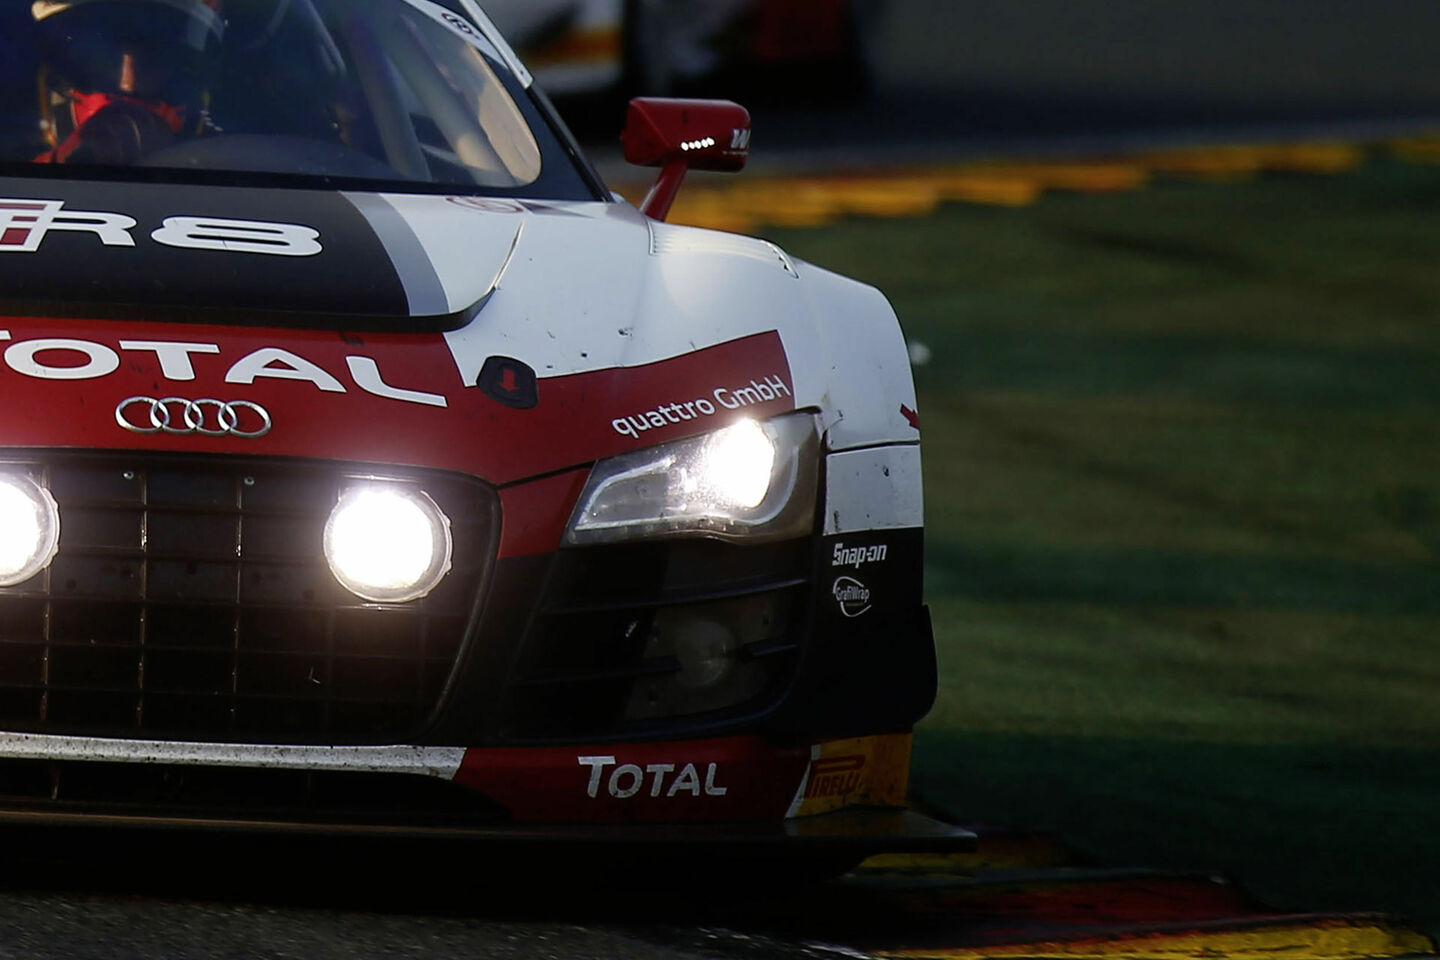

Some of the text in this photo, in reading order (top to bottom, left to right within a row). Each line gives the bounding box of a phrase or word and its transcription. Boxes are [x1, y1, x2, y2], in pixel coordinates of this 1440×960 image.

[611, 374, 792, 437] quattro GmbH
[832, 542, 887, 569] Snap-on
[577, 755, 728, 798] TOTAL
